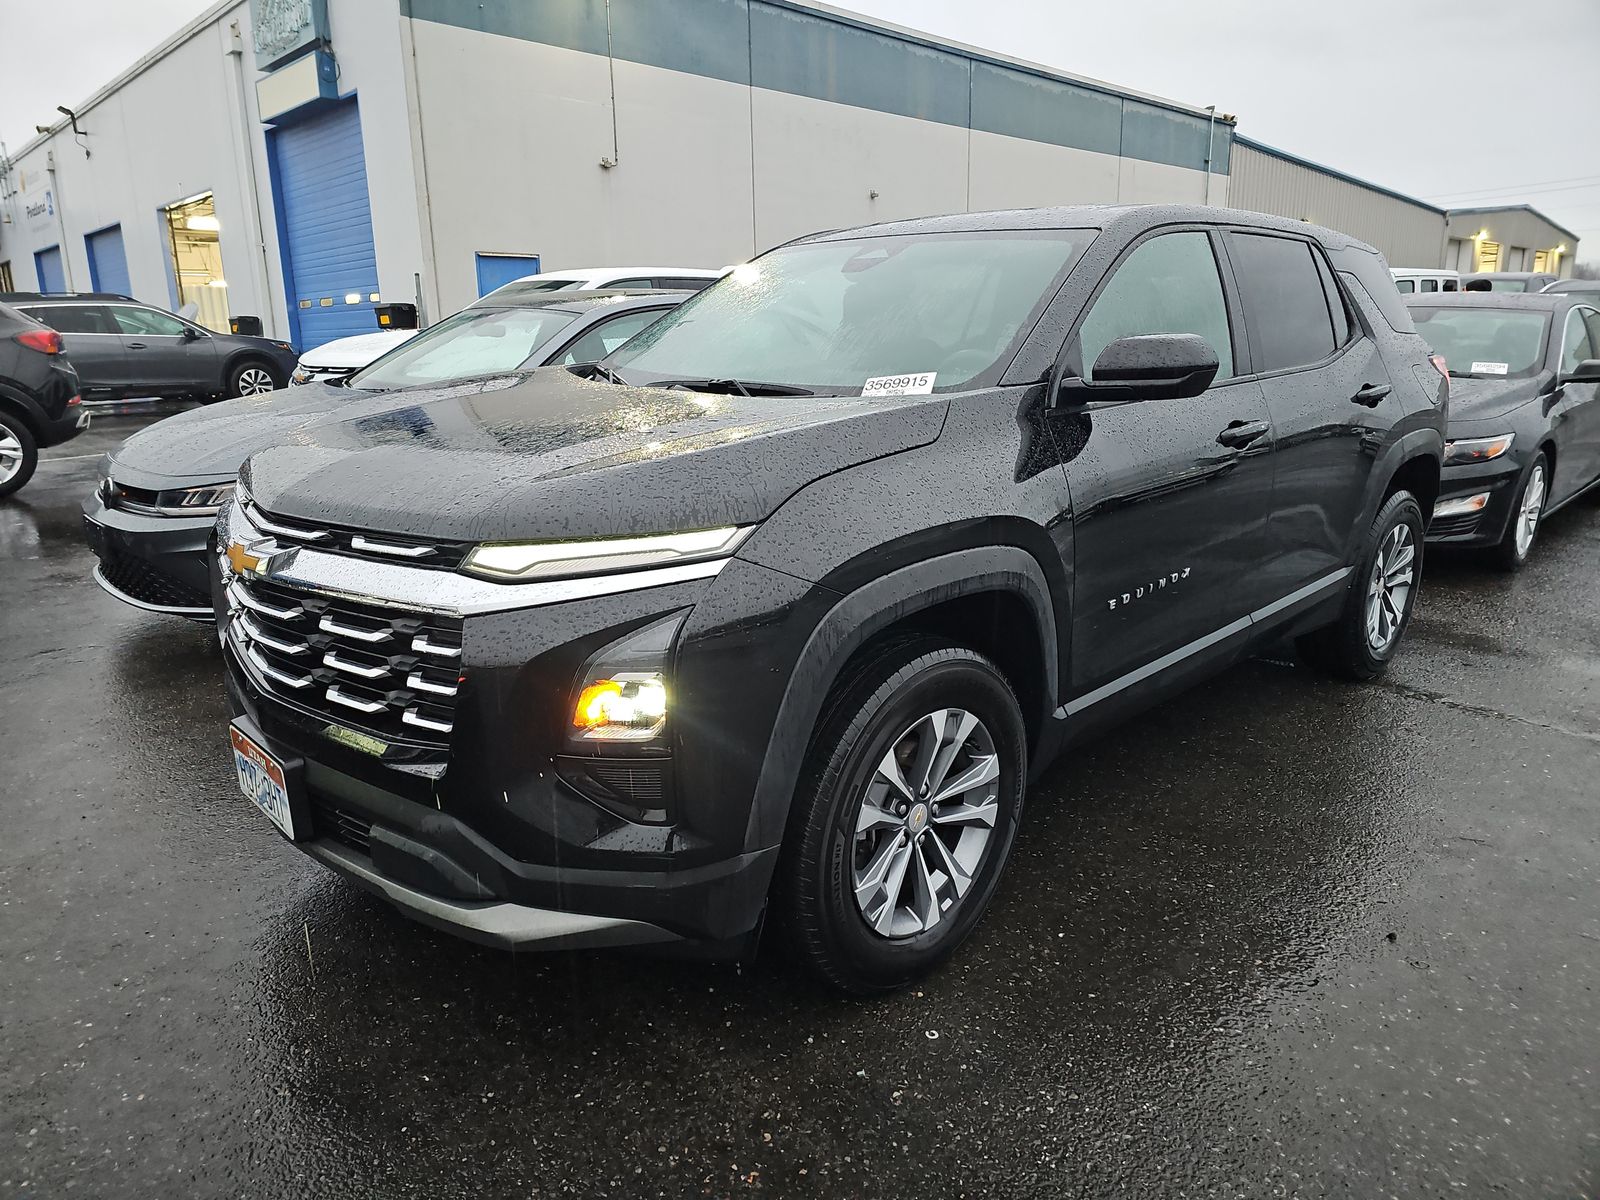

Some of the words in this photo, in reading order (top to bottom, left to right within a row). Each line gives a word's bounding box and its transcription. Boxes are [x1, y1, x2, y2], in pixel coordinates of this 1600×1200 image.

[865, 375, 929, 391] 3569915
[1107, 567, 1191, 610] EQUINOX
[247, 745, 267, 770] UTAH
